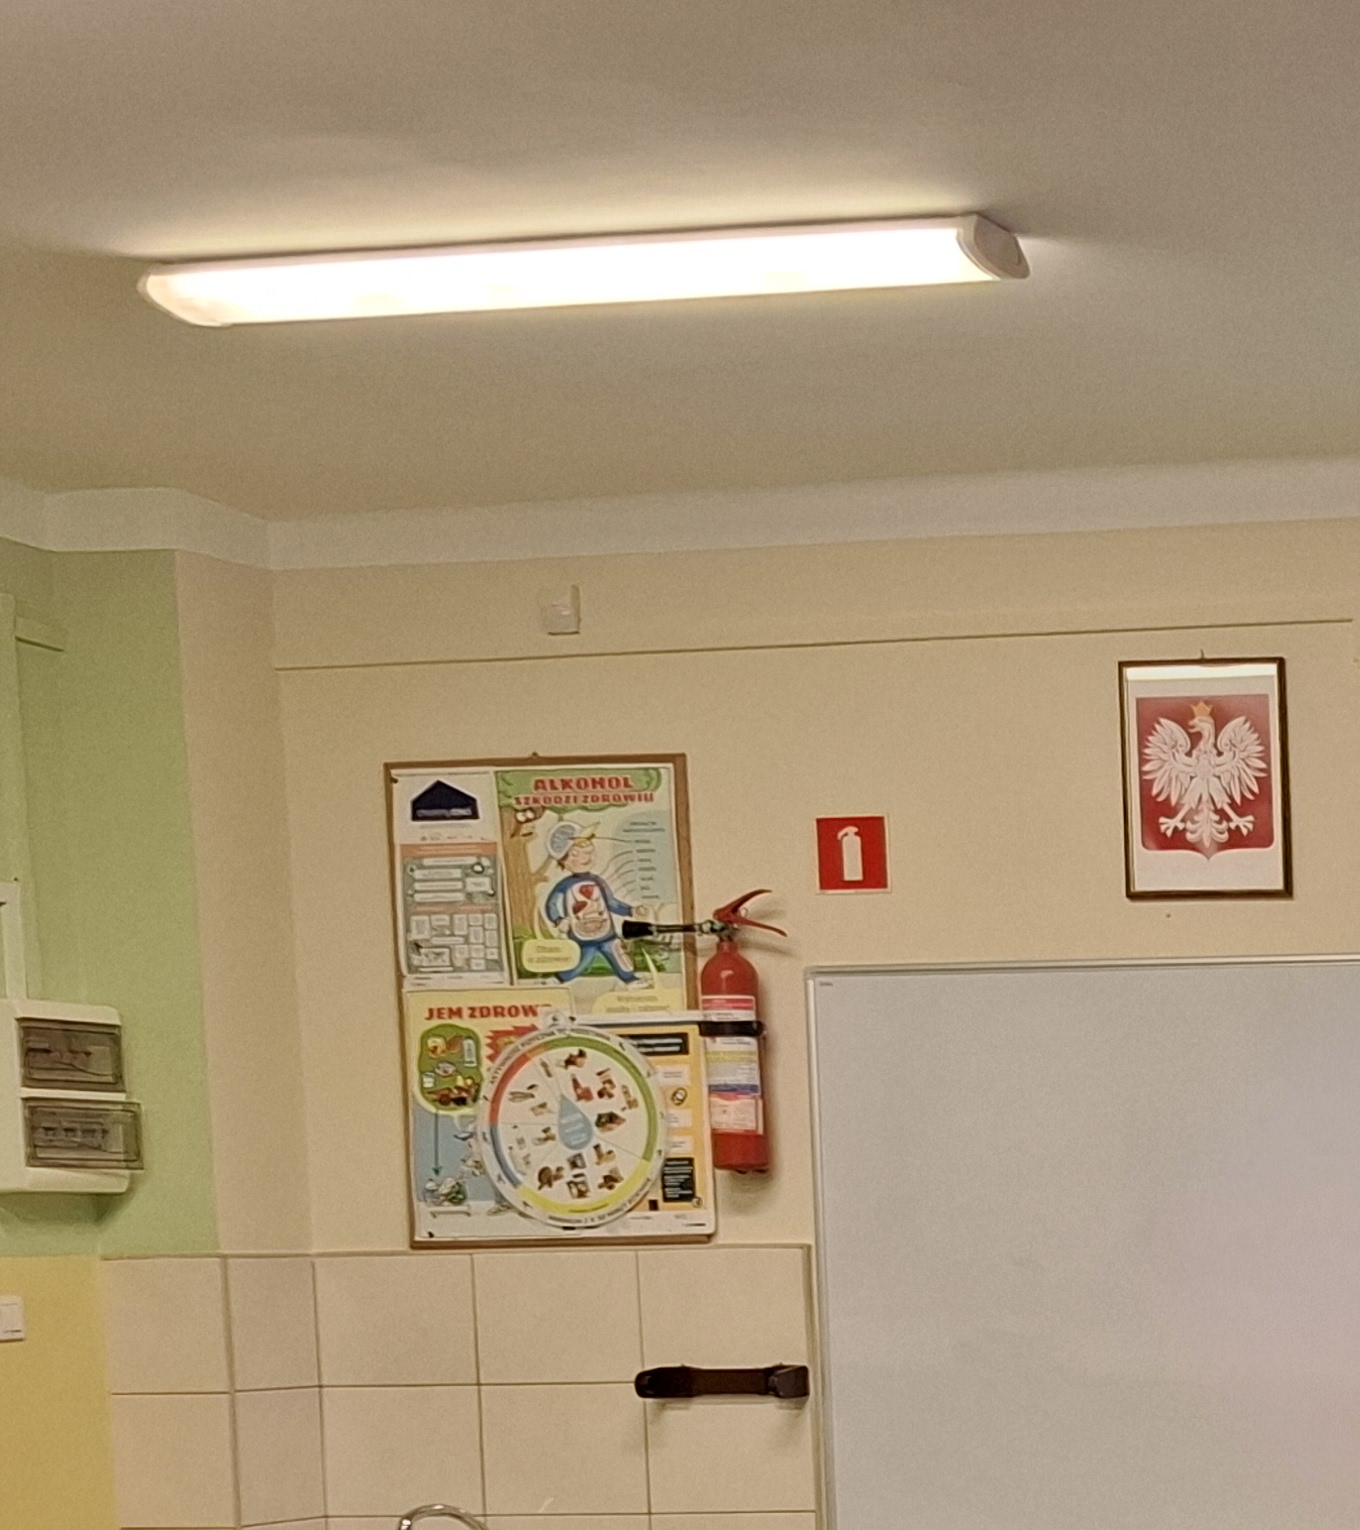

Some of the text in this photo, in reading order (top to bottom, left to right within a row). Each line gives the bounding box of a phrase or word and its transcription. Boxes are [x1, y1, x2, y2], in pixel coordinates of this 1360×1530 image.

[533, 776, 634, 791] ALKOHOL
[424, 1003, 552, 1021] JEM ZDROW
